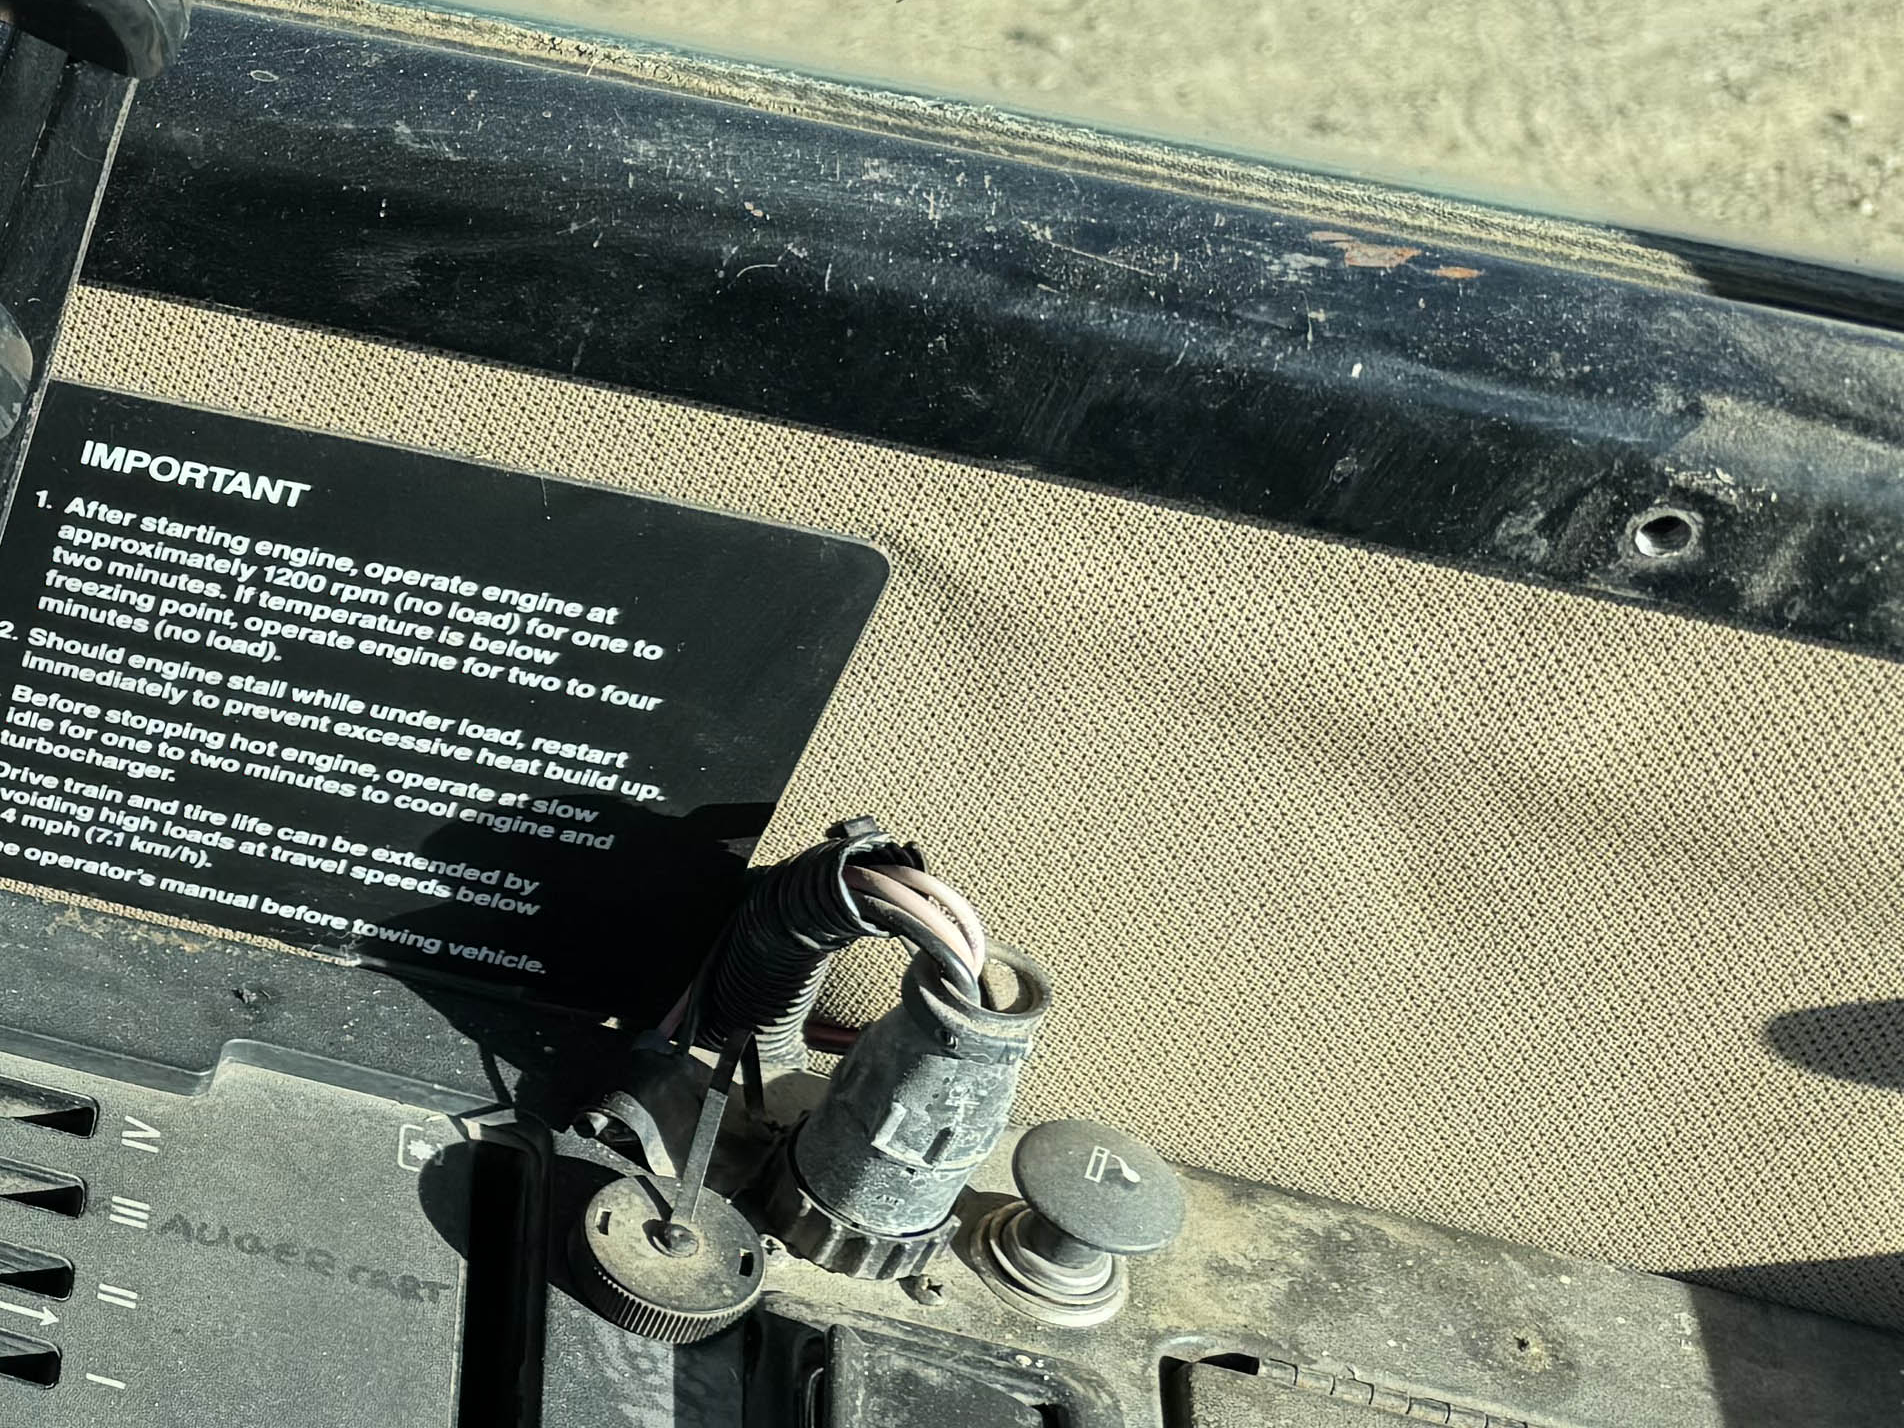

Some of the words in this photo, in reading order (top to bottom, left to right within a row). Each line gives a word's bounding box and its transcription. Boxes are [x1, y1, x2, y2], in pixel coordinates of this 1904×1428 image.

[79, 439, 312, 507] IMPORTANT
[27, 626, 126, 664] Should
[127, 653, 223, 685] engine
[226, 674, 288, 698] stall
[291, 687, 366, 714] while
[368, 703, 456, 732] under
[456, 717, 526, 750] load,
[530, 736, 629, 769] restart
[23, 846, 156, 887] operator's
[158, 877, 259, 910] manual
[259, 896, 349, 930] before
[350, 917, 442, 954] towing
[447, 941, 546, 974] vehicle.
